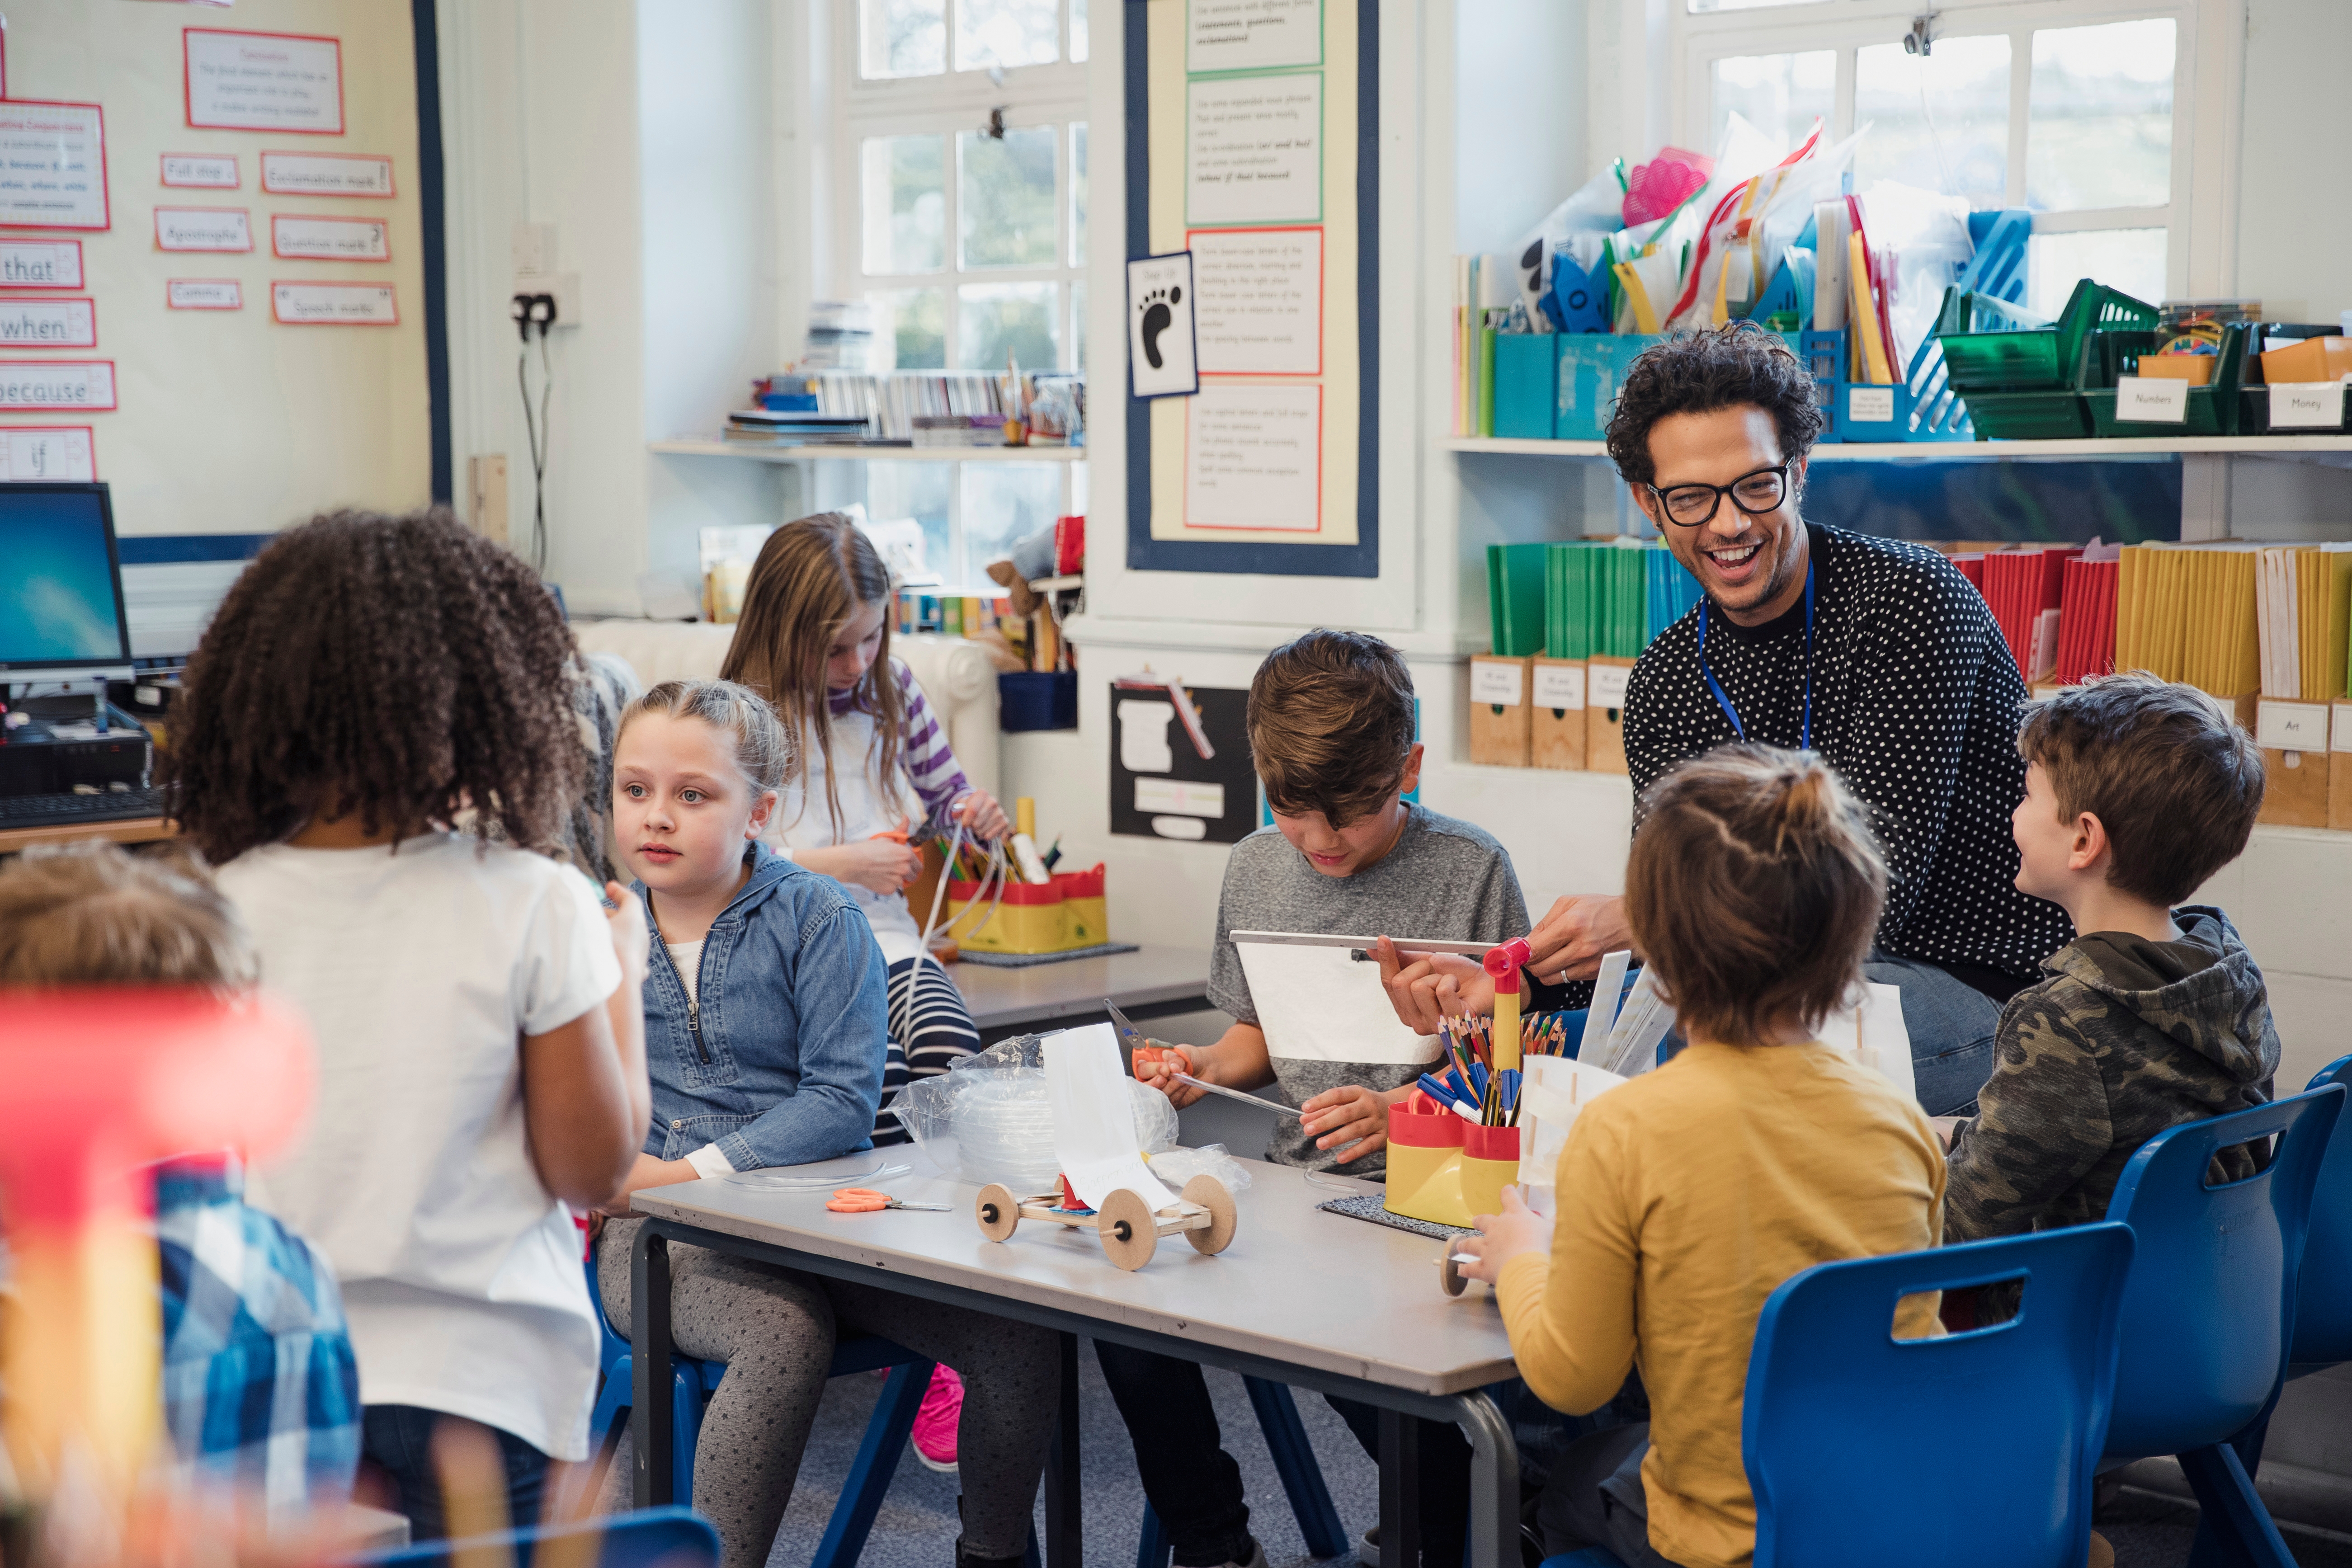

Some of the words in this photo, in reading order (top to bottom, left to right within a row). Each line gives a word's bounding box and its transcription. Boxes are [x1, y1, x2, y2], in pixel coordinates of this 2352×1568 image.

[4, 254, 53, 278] that
[1, 312, 67, 337] when
[2135, 393, 2172, 405] Numbers
[2292, 398, 2321, 411] Money
[31, 442, 47, 476] if
[2285, 720, 2300, 731] Art
[1080, 1169, 1123, 1194] Saffron
[1126, 1157, 1142, 1173] and
